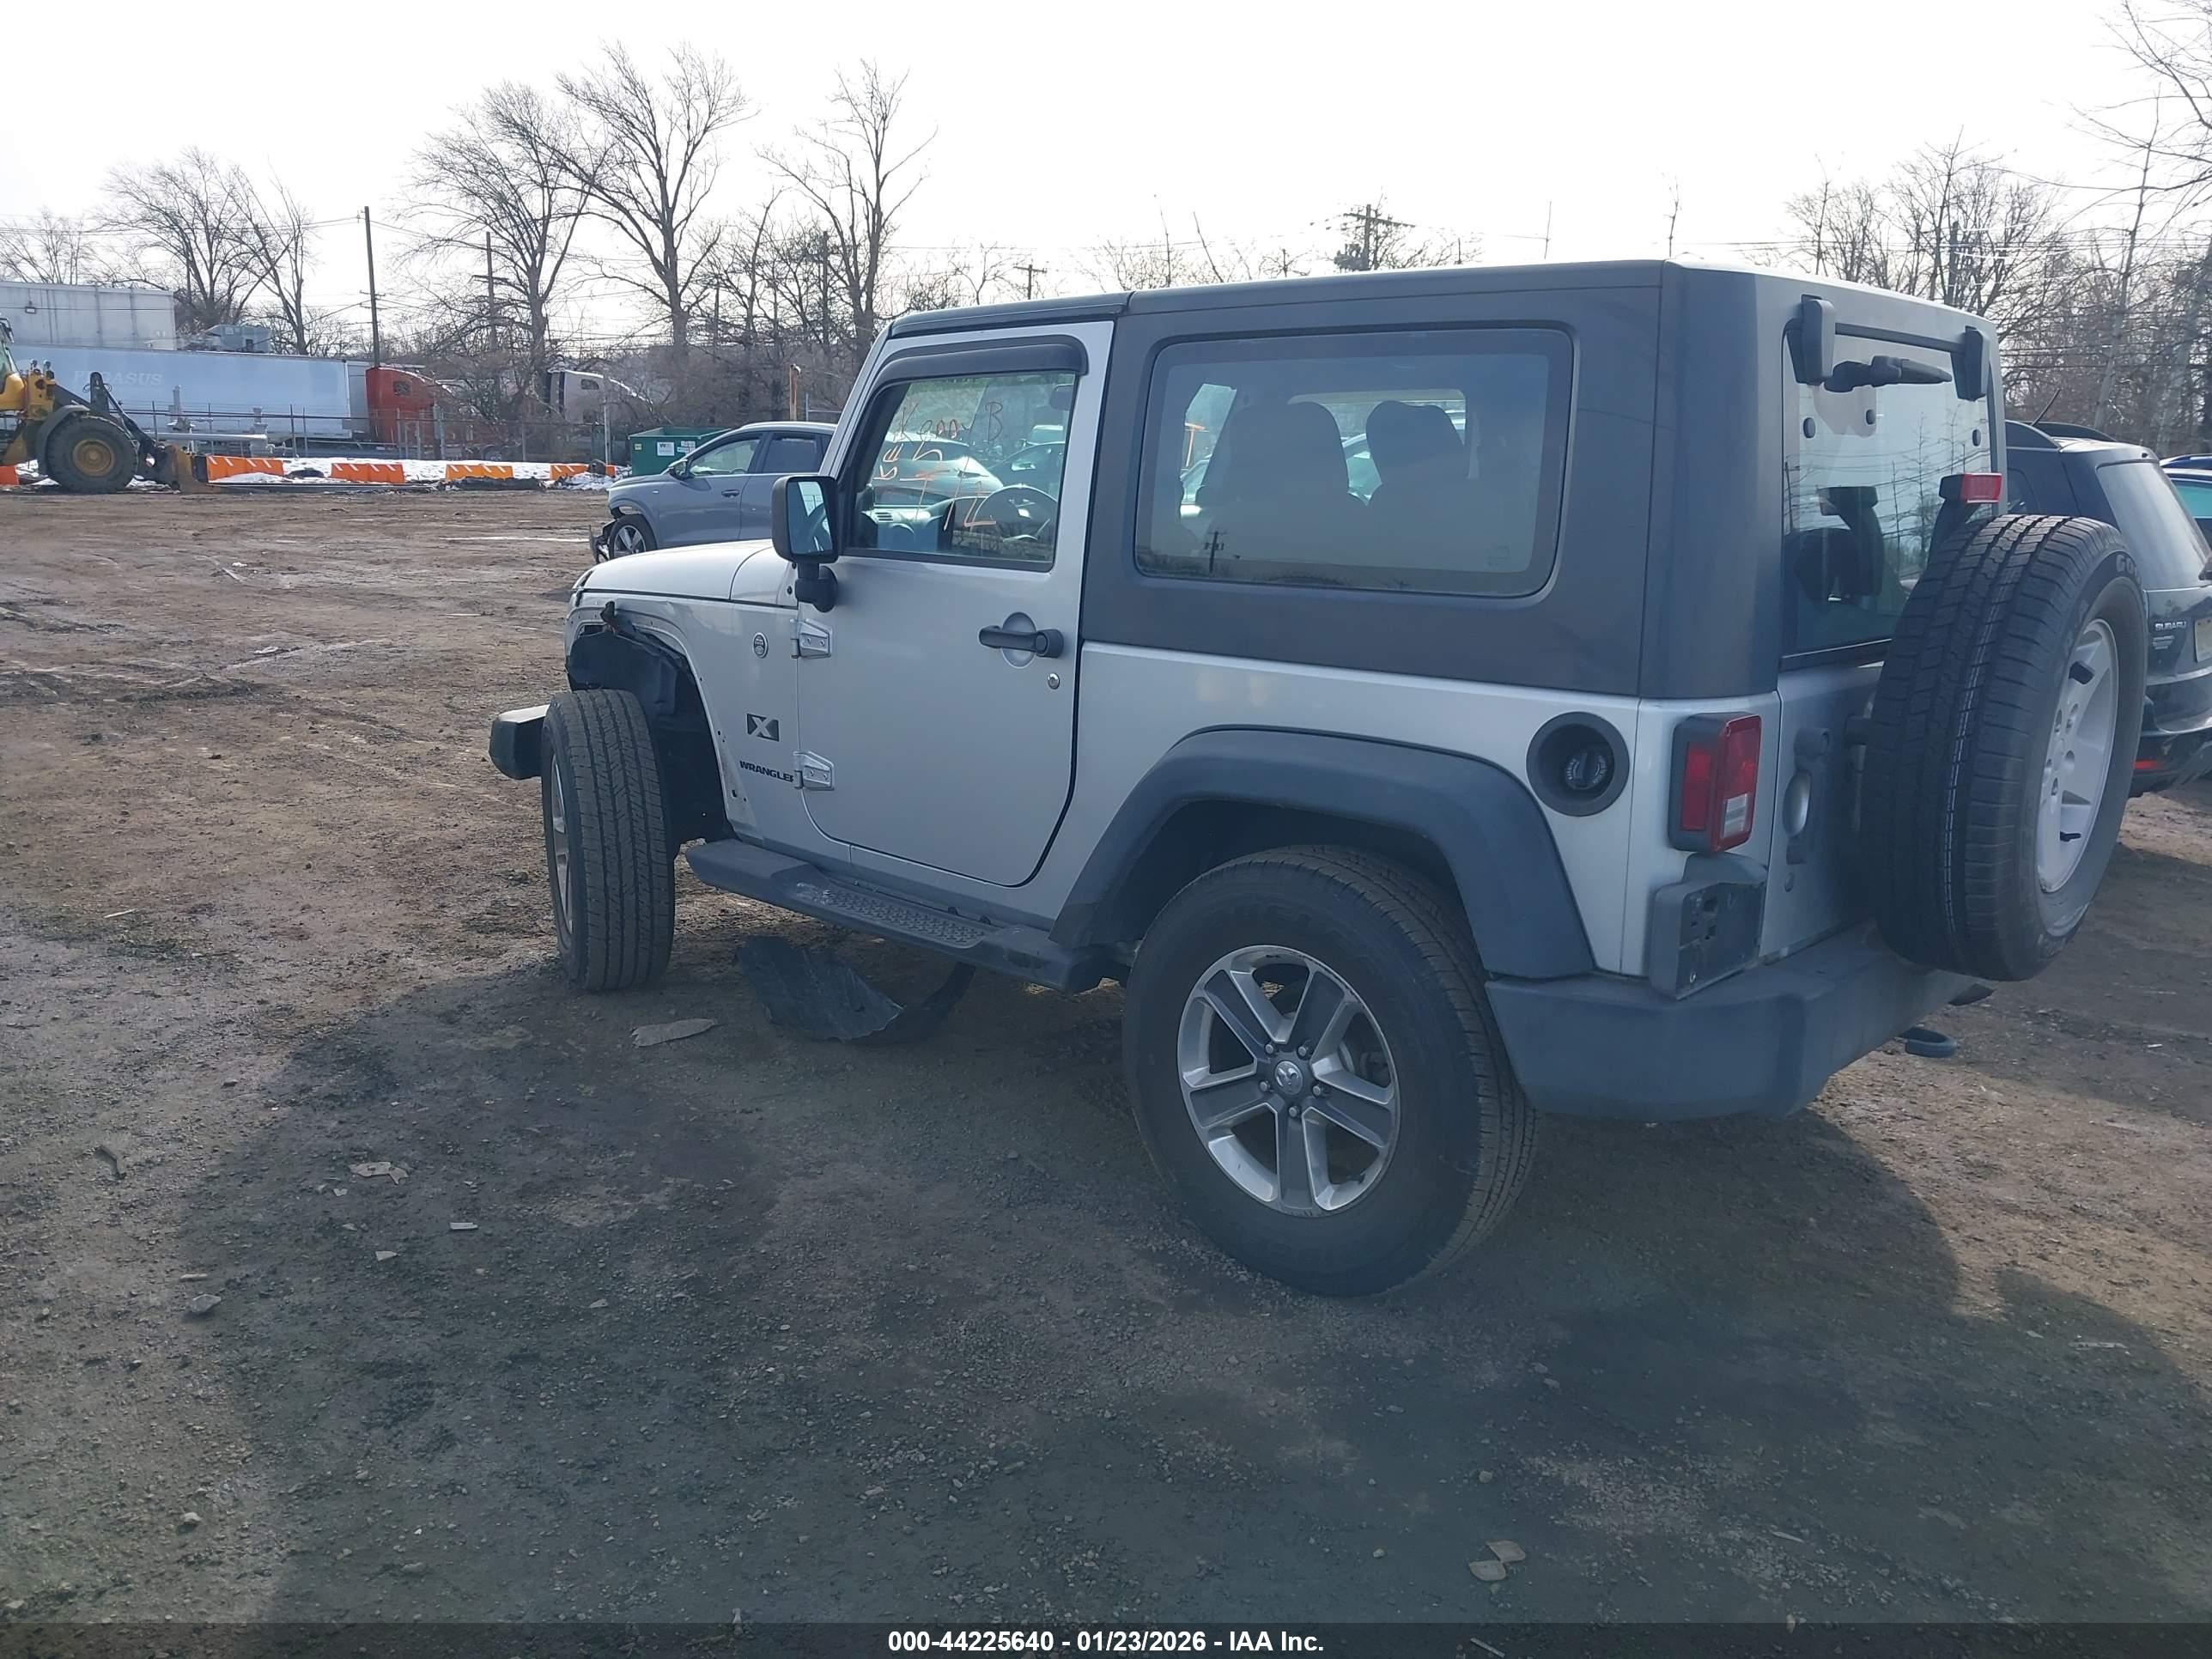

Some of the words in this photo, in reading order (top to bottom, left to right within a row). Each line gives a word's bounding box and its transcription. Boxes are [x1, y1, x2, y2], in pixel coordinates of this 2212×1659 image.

[985, 402, 1003, 444] B
[2154, 621, 2186, 630] SUBARU
[747, 714, 779, 742] X
